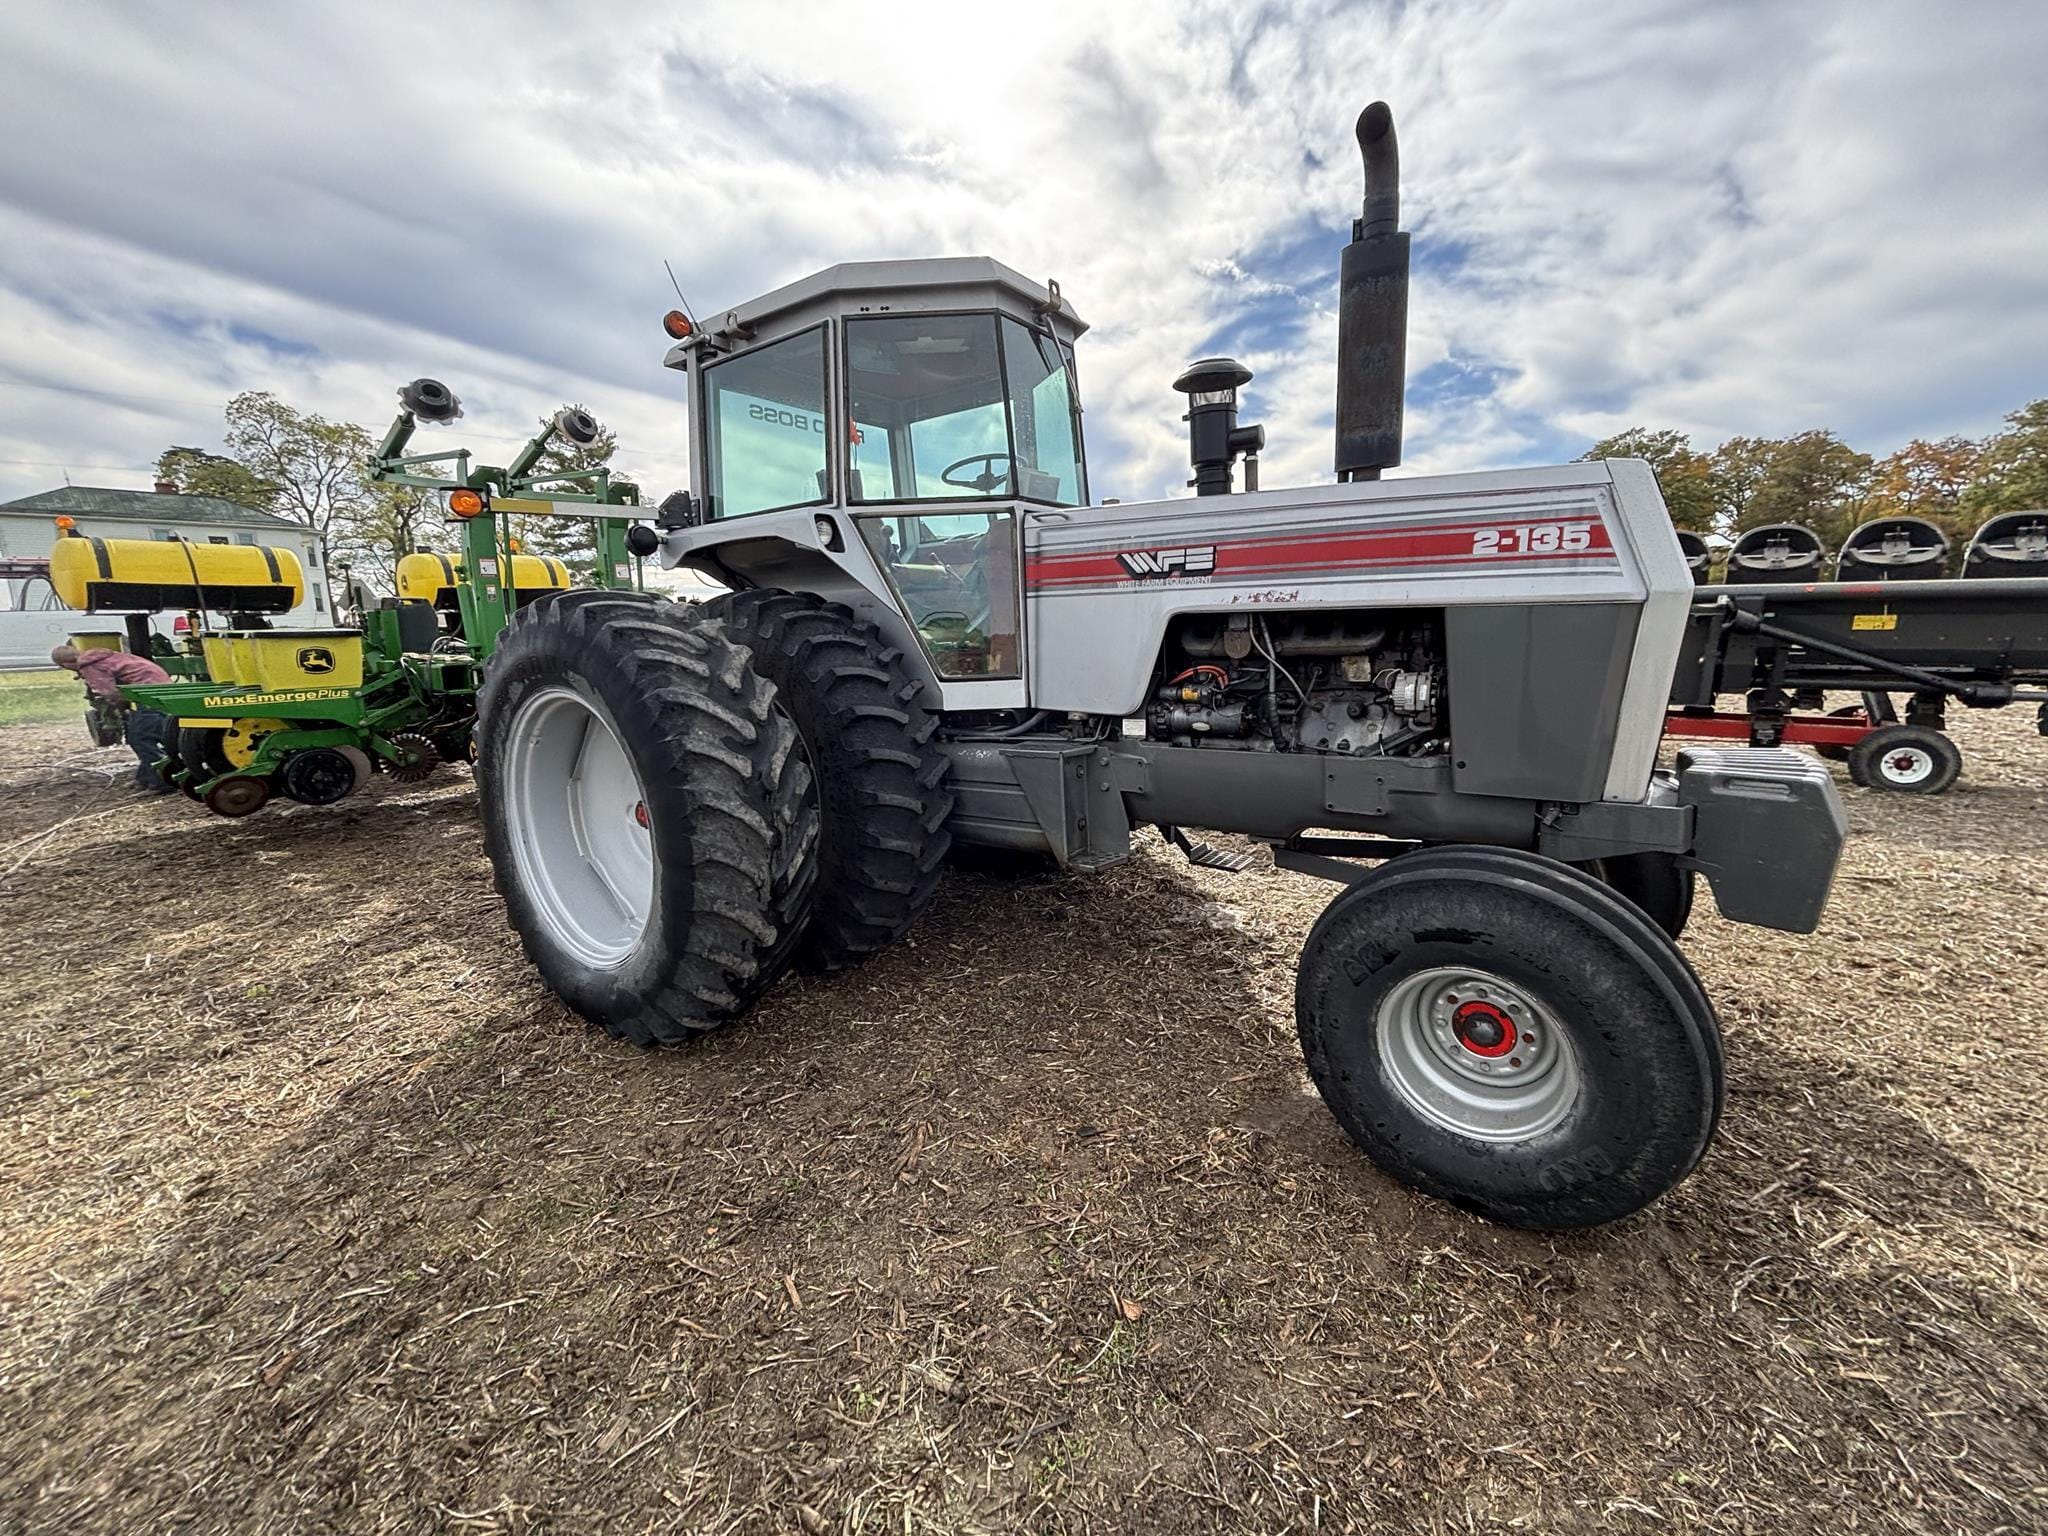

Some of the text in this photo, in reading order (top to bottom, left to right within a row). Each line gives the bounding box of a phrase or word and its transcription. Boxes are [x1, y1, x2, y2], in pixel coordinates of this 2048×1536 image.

[1473, 524, 1591, 555] 2-135
[1116, 575, 1213, 590] WHITE FARM EQUIPMENT
